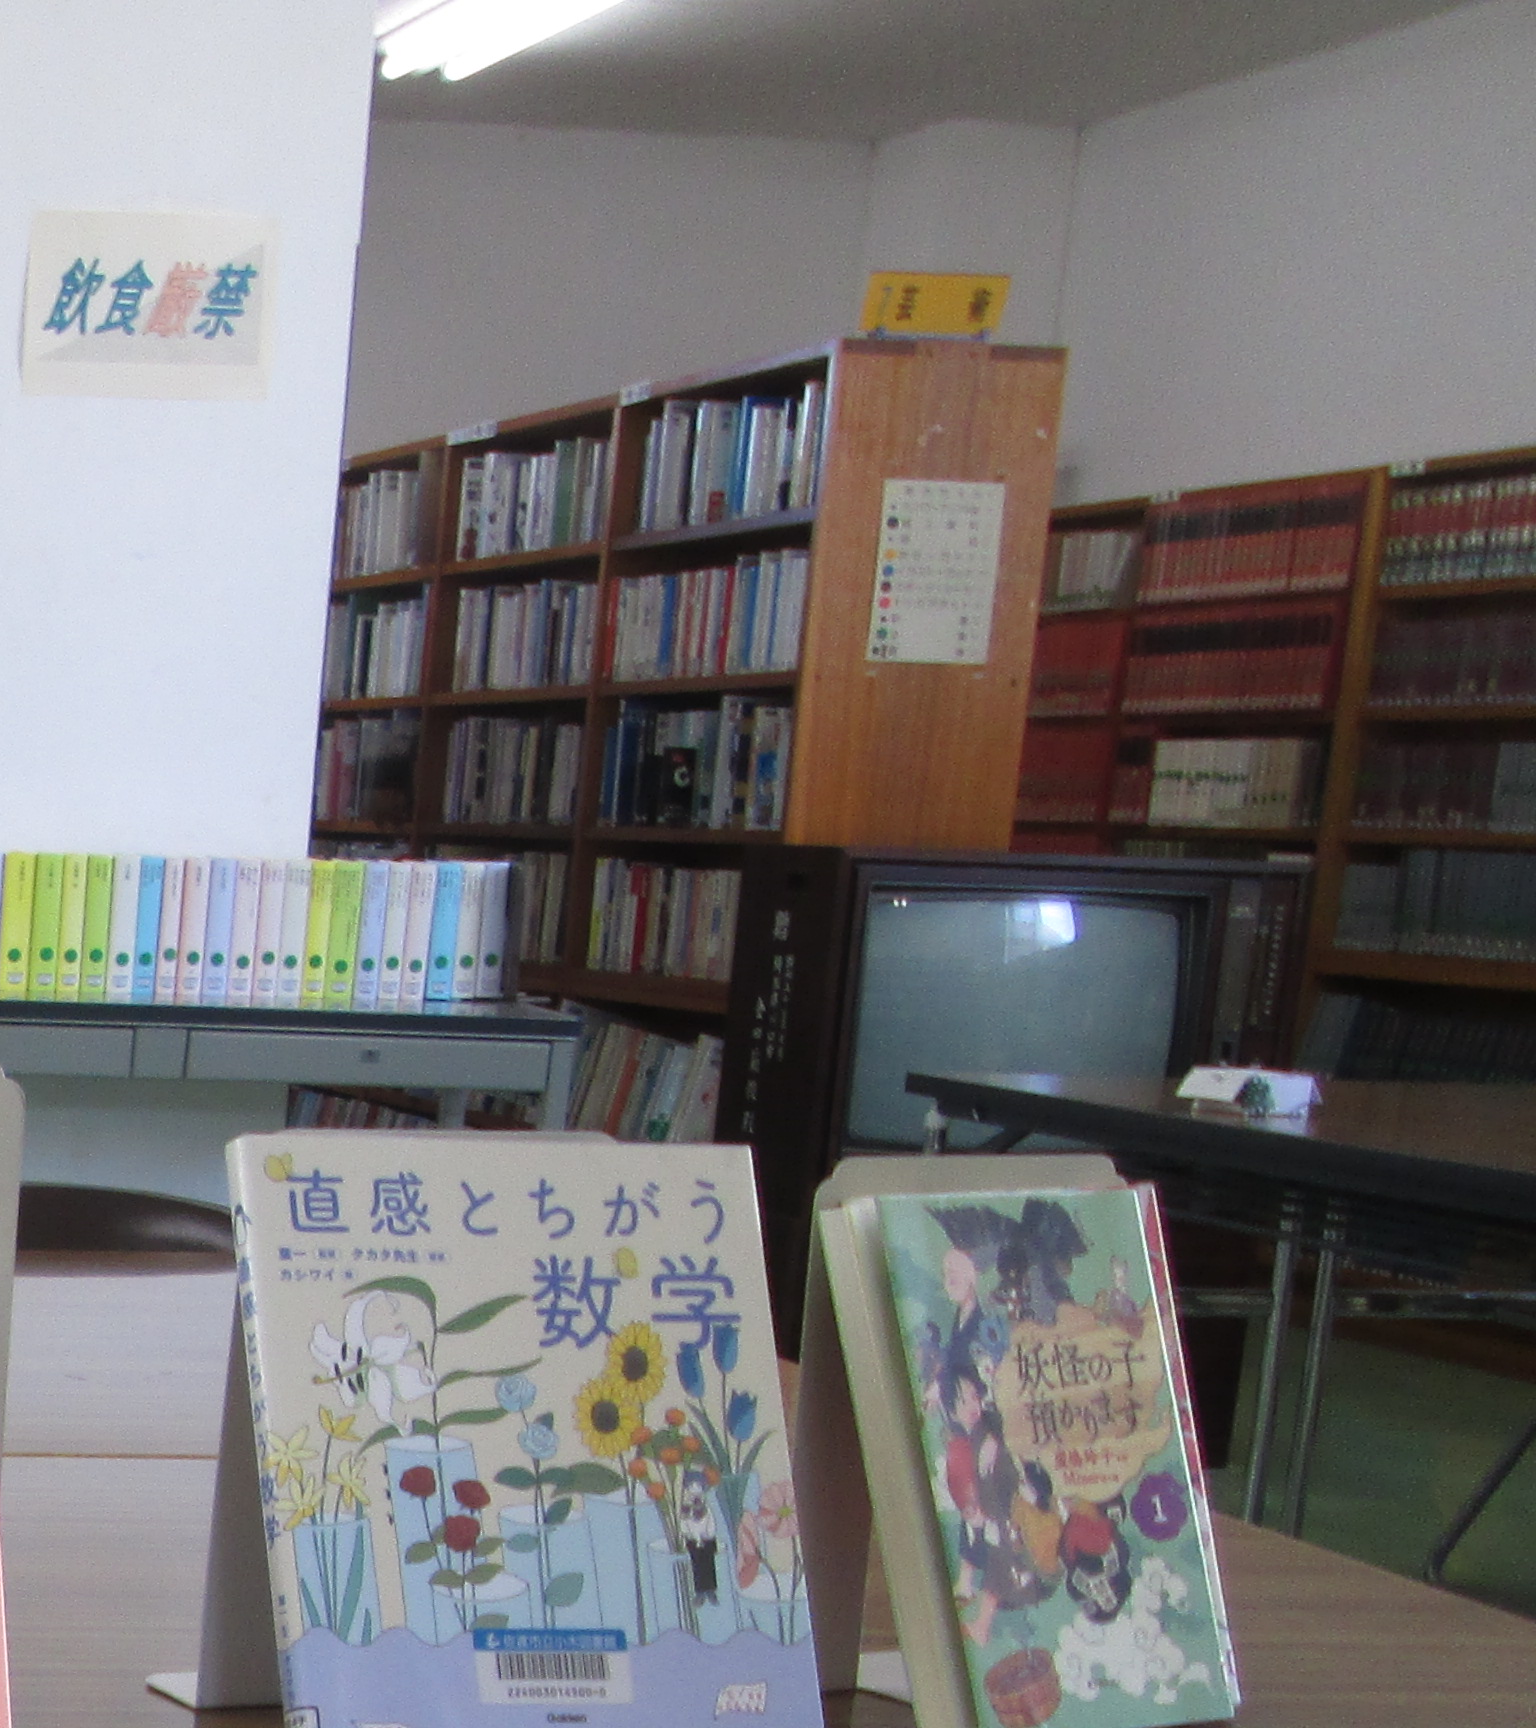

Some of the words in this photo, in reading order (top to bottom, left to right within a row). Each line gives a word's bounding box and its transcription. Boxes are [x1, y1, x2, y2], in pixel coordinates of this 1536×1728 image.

[43, 257, 259, 339] 飲食厳禁
[288, 1169, 725, 1243] 直感とちがう
[532, 1254, 741, 1349] 数学
[1014, 1339, 1147, 1393] 妖怪の子
[1027, 1396, 1145, 1446] 預かります
[1151, 1494, 1165, 1522] 1
